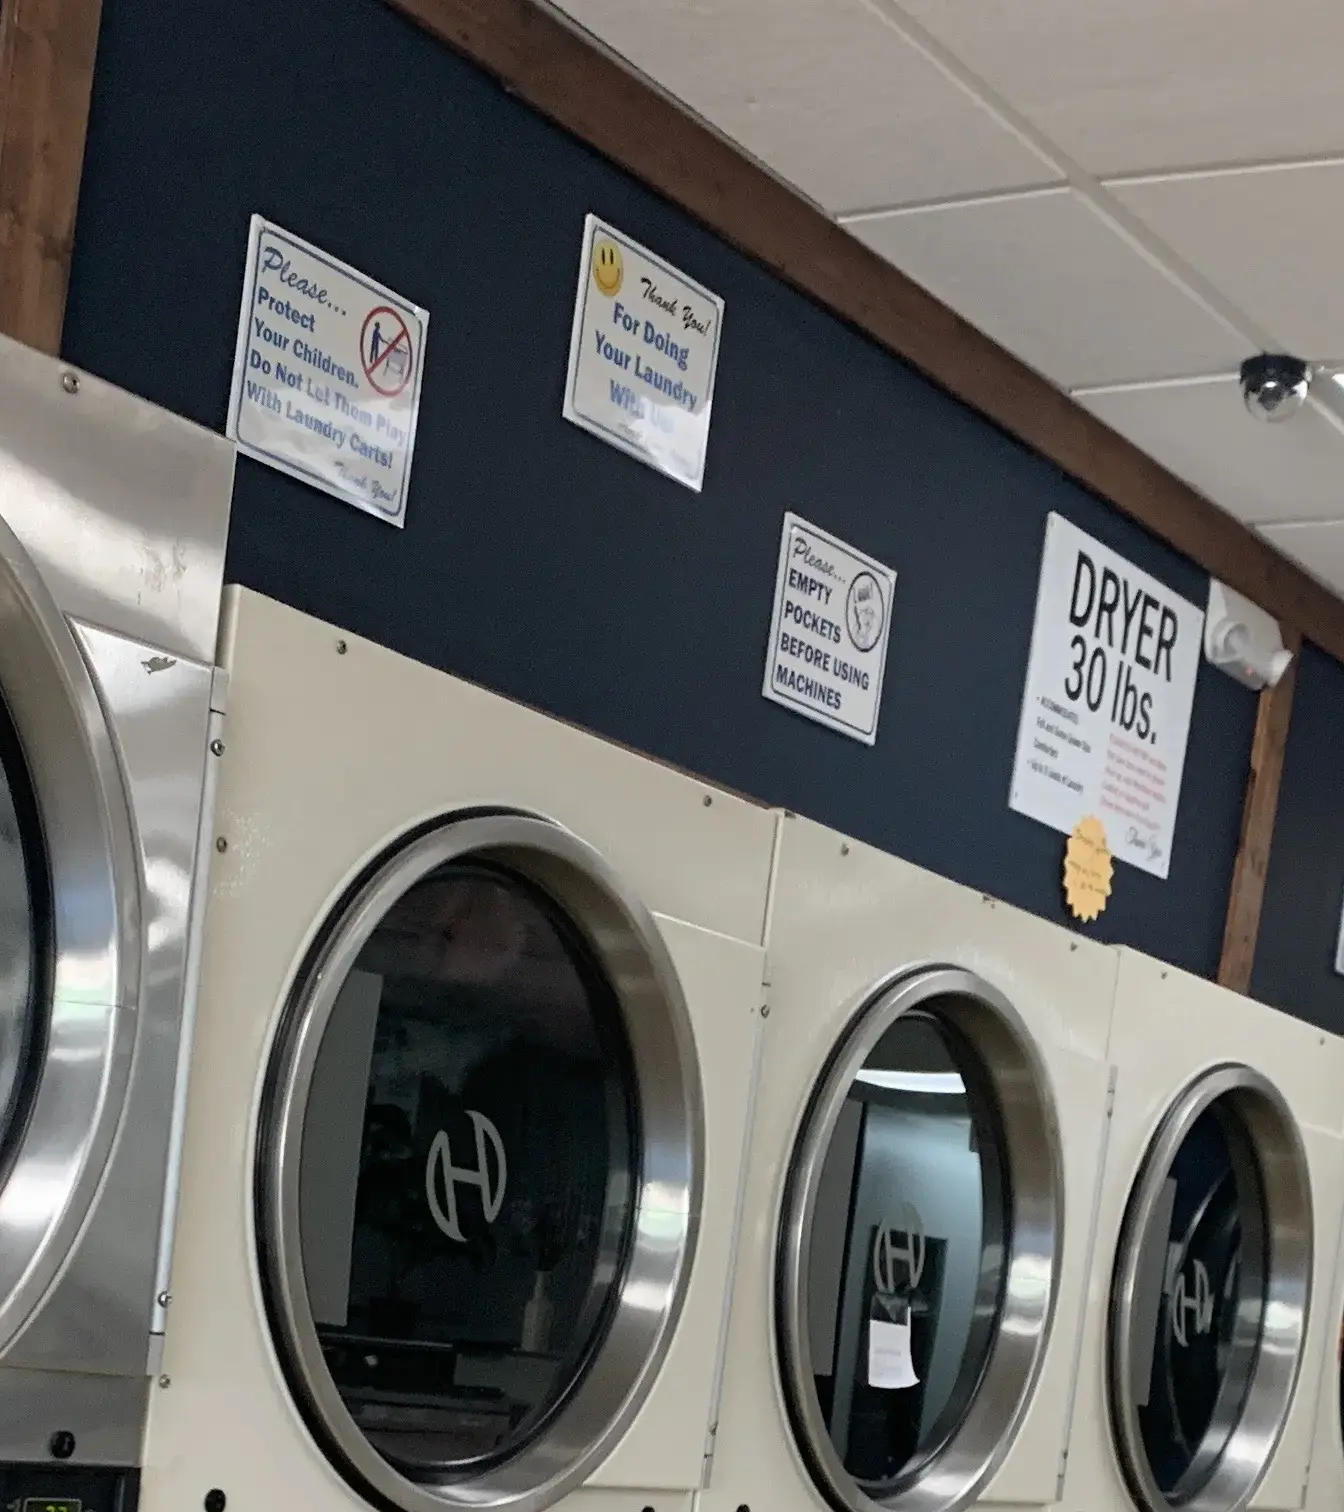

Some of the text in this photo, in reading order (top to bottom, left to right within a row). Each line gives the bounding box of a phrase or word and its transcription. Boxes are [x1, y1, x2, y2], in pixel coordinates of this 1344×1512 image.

[258, 286, 316, 333] Protect
[612, 302, 689, 371] For Doing
[641, 277, 711, 337] Thank You!
[254, 316, 359, 389] Your Children.
[595, 330, 698, 412] Your Laundry
[247, 380, 393, 469] With Laundry Carts!
[250, 350, 406, 447] Do Not Let Them Play
[788, 568, 833, 605] EMPTY
[1069, 549, 1178, 683] DRYER
[784, 600, 842, 644] POCKETS
[776, 664, 842, 710] MACHINES
[781, 633, 870, 691] BEFORE USING
[1064, 635, 1107, 712] 30
[1110, 661, 1157, 745] lbs.
